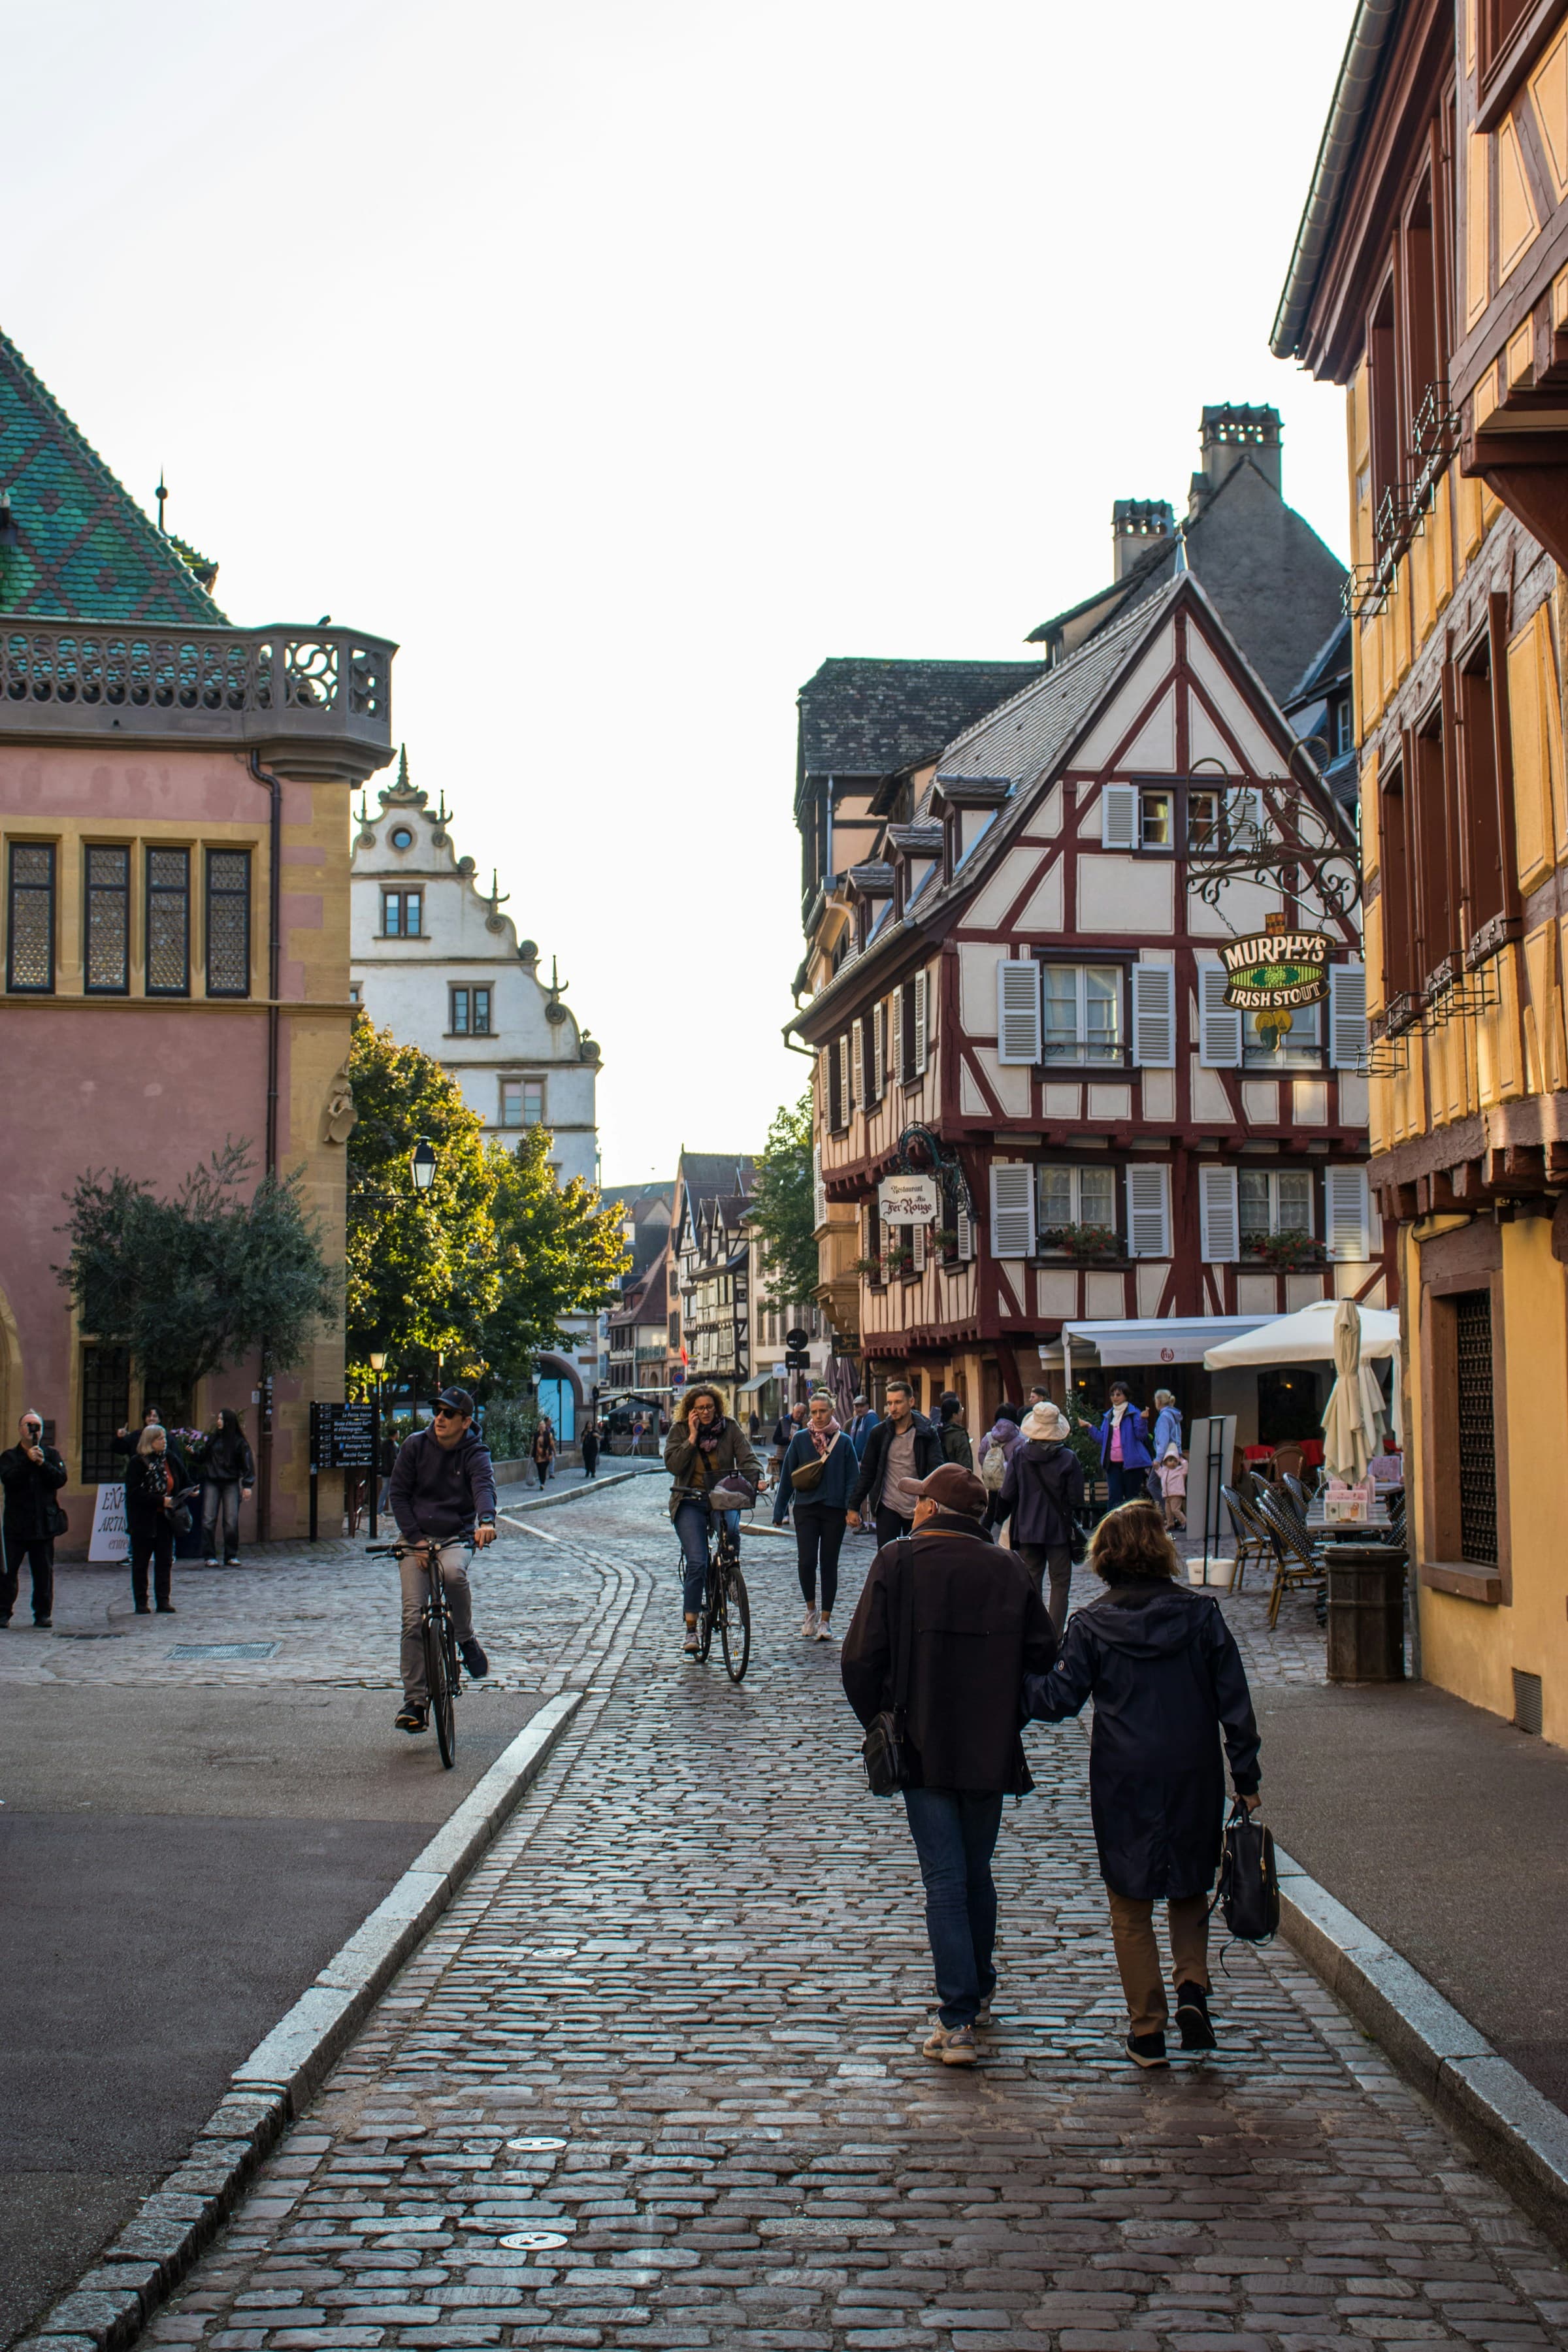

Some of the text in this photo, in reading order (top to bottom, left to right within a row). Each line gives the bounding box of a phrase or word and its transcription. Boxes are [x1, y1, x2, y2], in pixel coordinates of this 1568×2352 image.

[1224, 935, 1327, 972] MURPHY'S
[1230, 981, 1321, 1007] IRISH STOUT
[890, 1184, 923, 1194] Restaurant
[881, 1198, 932, 1217] Fer Rouge
